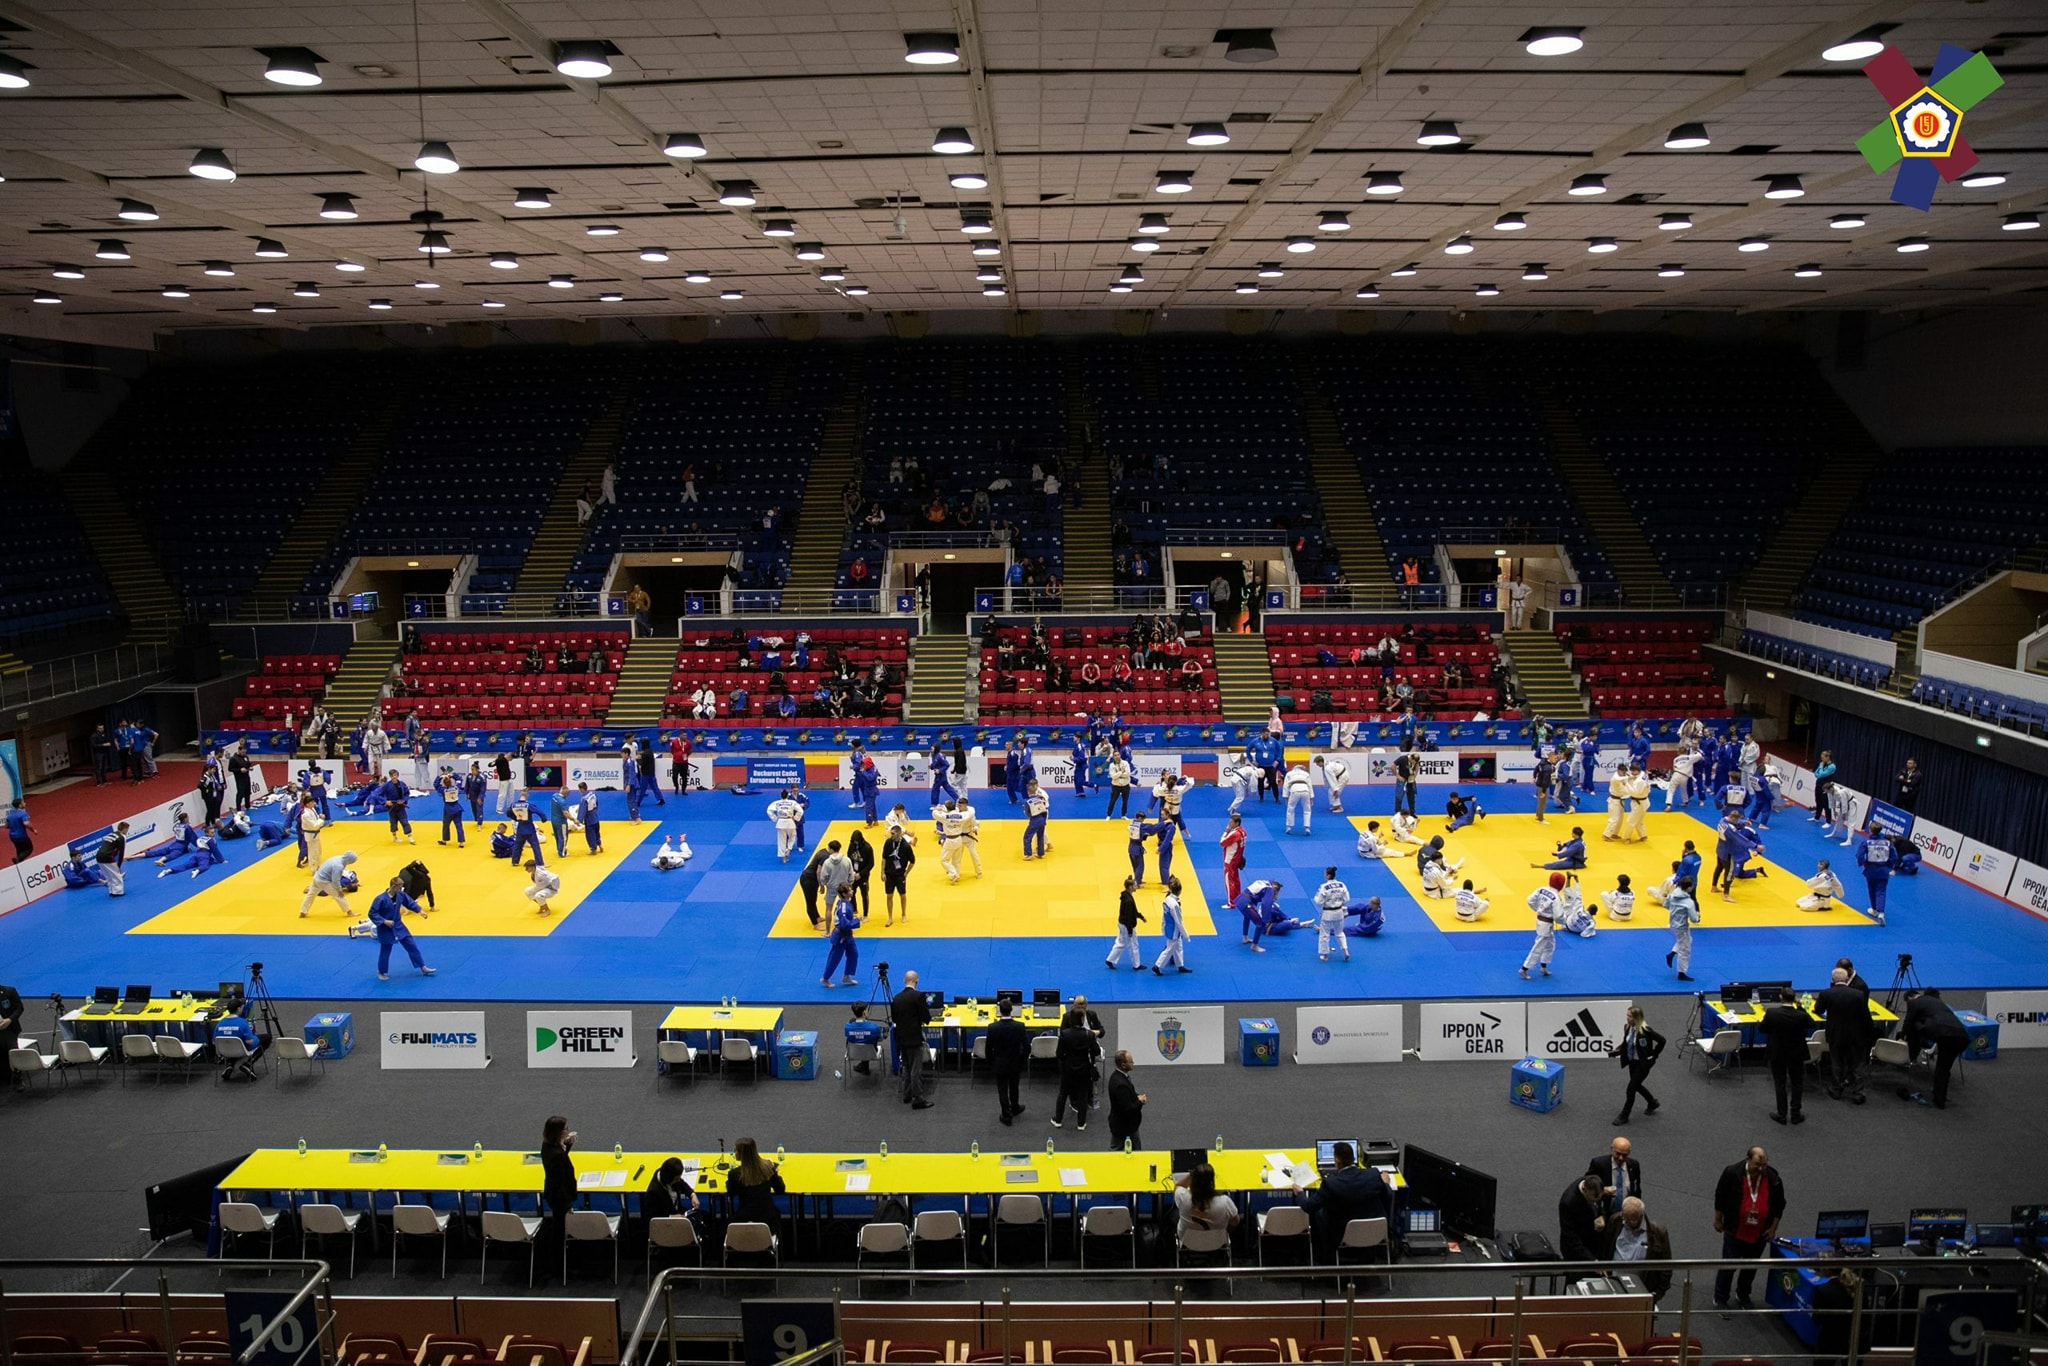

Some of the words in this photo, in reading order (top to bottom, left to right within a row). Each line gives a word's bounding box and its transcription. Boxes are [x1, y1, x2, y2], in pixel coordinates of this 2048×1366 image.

[1195, 596, 1203, 605] 4
[1272, 595, 1279, 604] 5
[1485, 593, 1492, 602] 5
[1564, 593, 1572, 602] 6
[612, 602, 619, 611] 2
[692, 601, 699, 610] 3
[901, 599, 908, 608] 3
[980, 598, 989, 607] 4
[338, 606, 343, 614] 1
[414, 604, 421, 613] 2
[1041, 767, 1066, 775] IPPON
[1419, 767, 1449, 775] HILL
[1913, 832, 1954, 860] essimo
[559, 1027, 623, 1039] GREEN
[1442, 1023, 1485, 1038] IPPON
[402, 1033, 478, 1044] FUJIMATS
[562, 1039, 615, 1052] HILL
[1466, 1039, 1504, 1054] GEAR
[1546, 1036, 1613, 1053] adidas
[239, 1314, 303, 1353] 10
[1949, 1316, 1984, 1355] 9
[773, 1324, 807, 1361] 9
